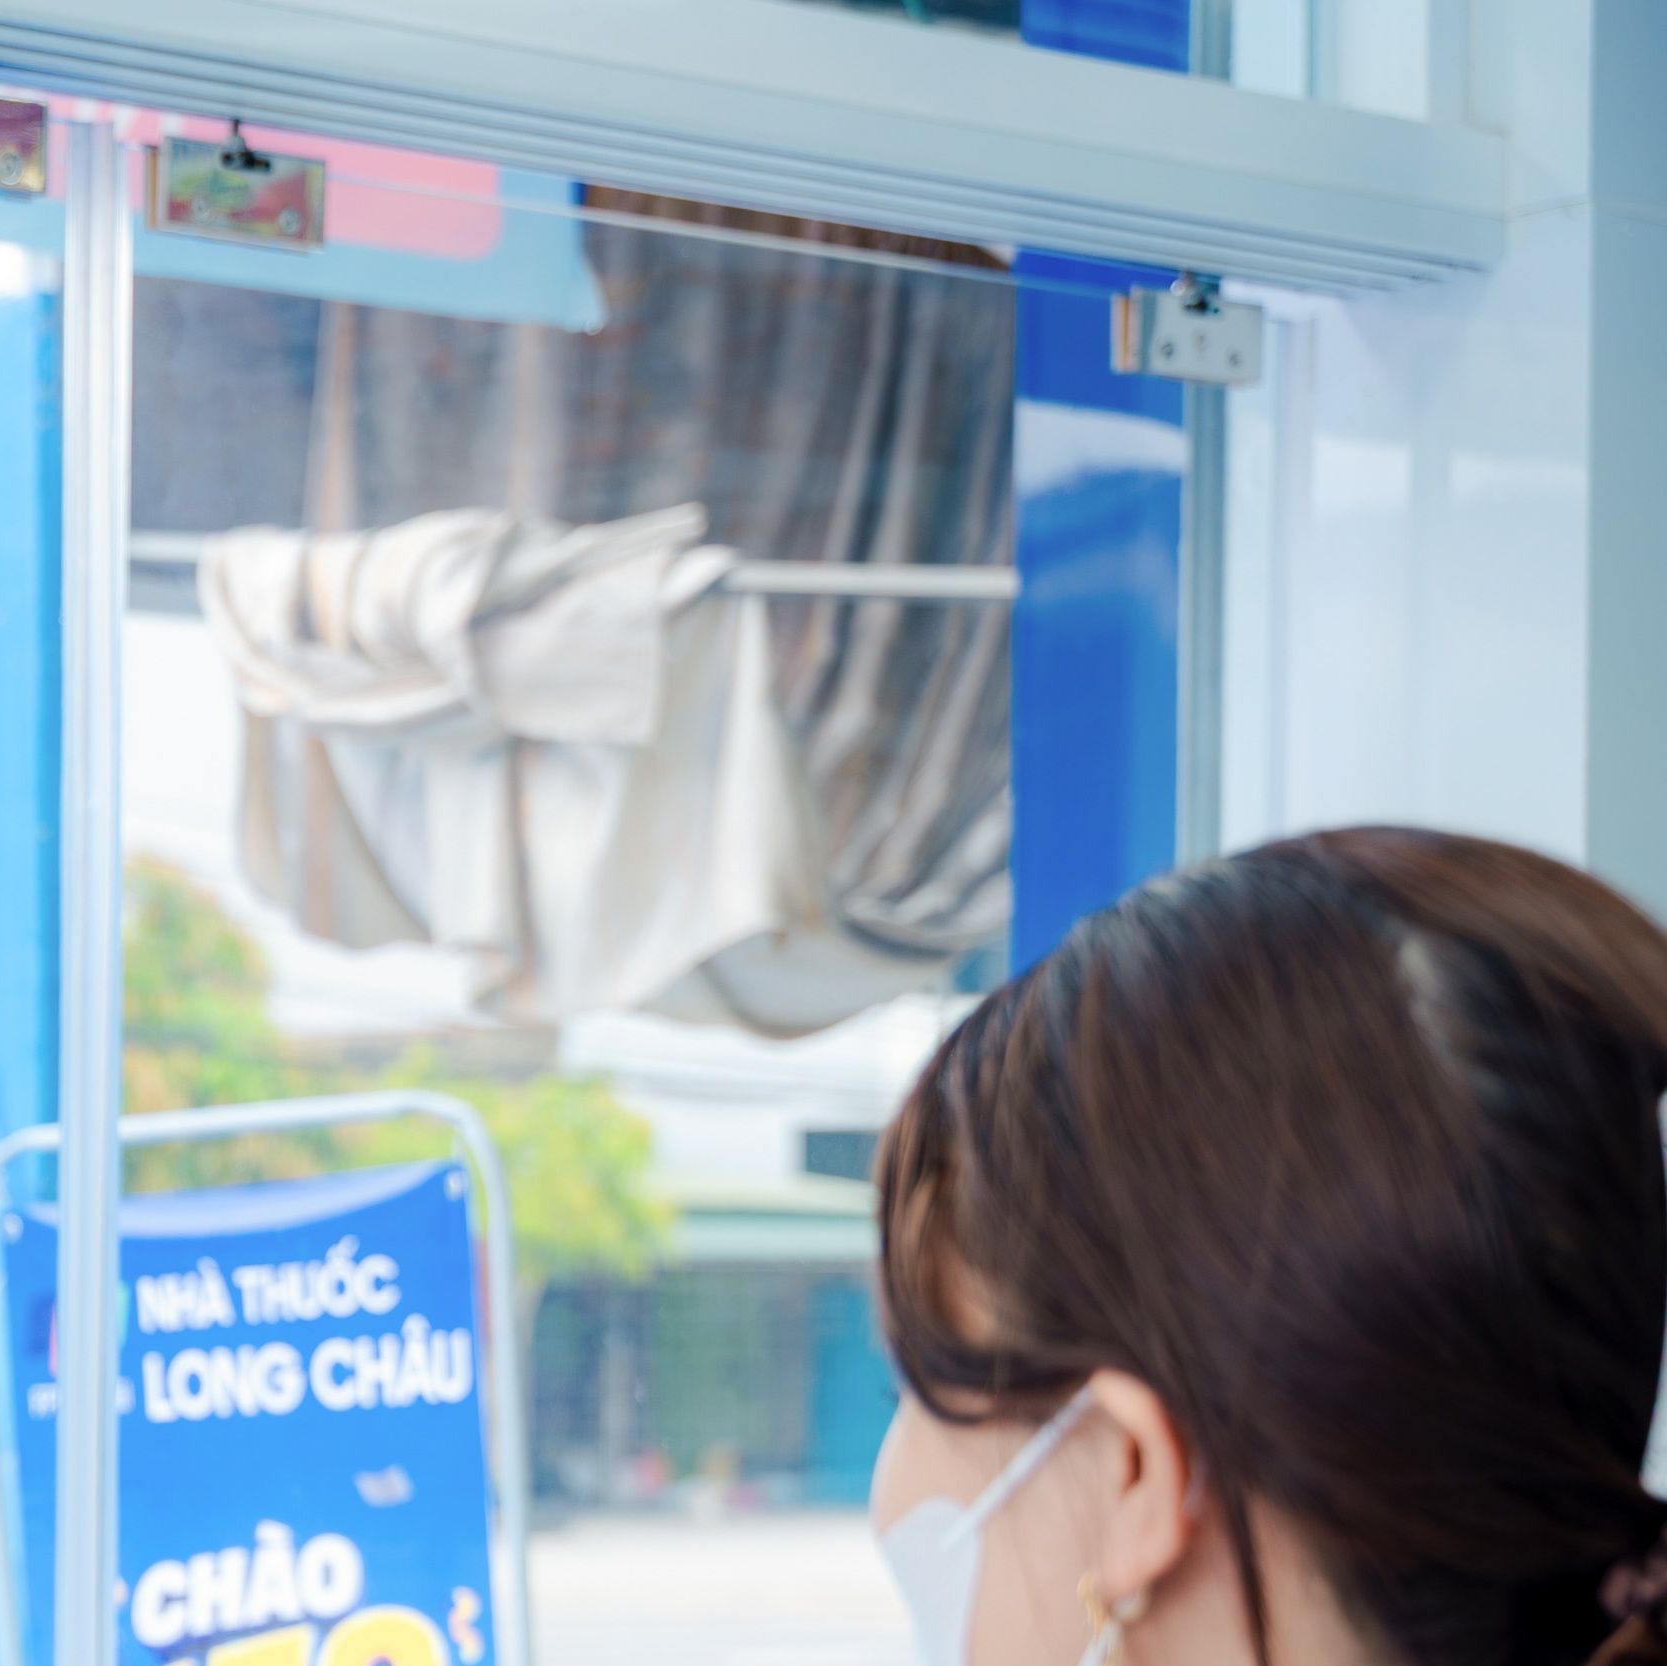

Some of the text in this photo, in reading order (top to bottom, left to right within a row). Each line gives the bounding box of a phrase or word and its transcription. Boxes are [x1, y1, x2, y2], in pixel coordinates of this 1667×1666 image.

[137, 1234, 402, 1334] NHÀ THUỐC
[143, 1341, 308, 1424] LONG
[310, 1313, 473, 1412] CHÂU
[132, 1519, 364, 1648] CHÀO
